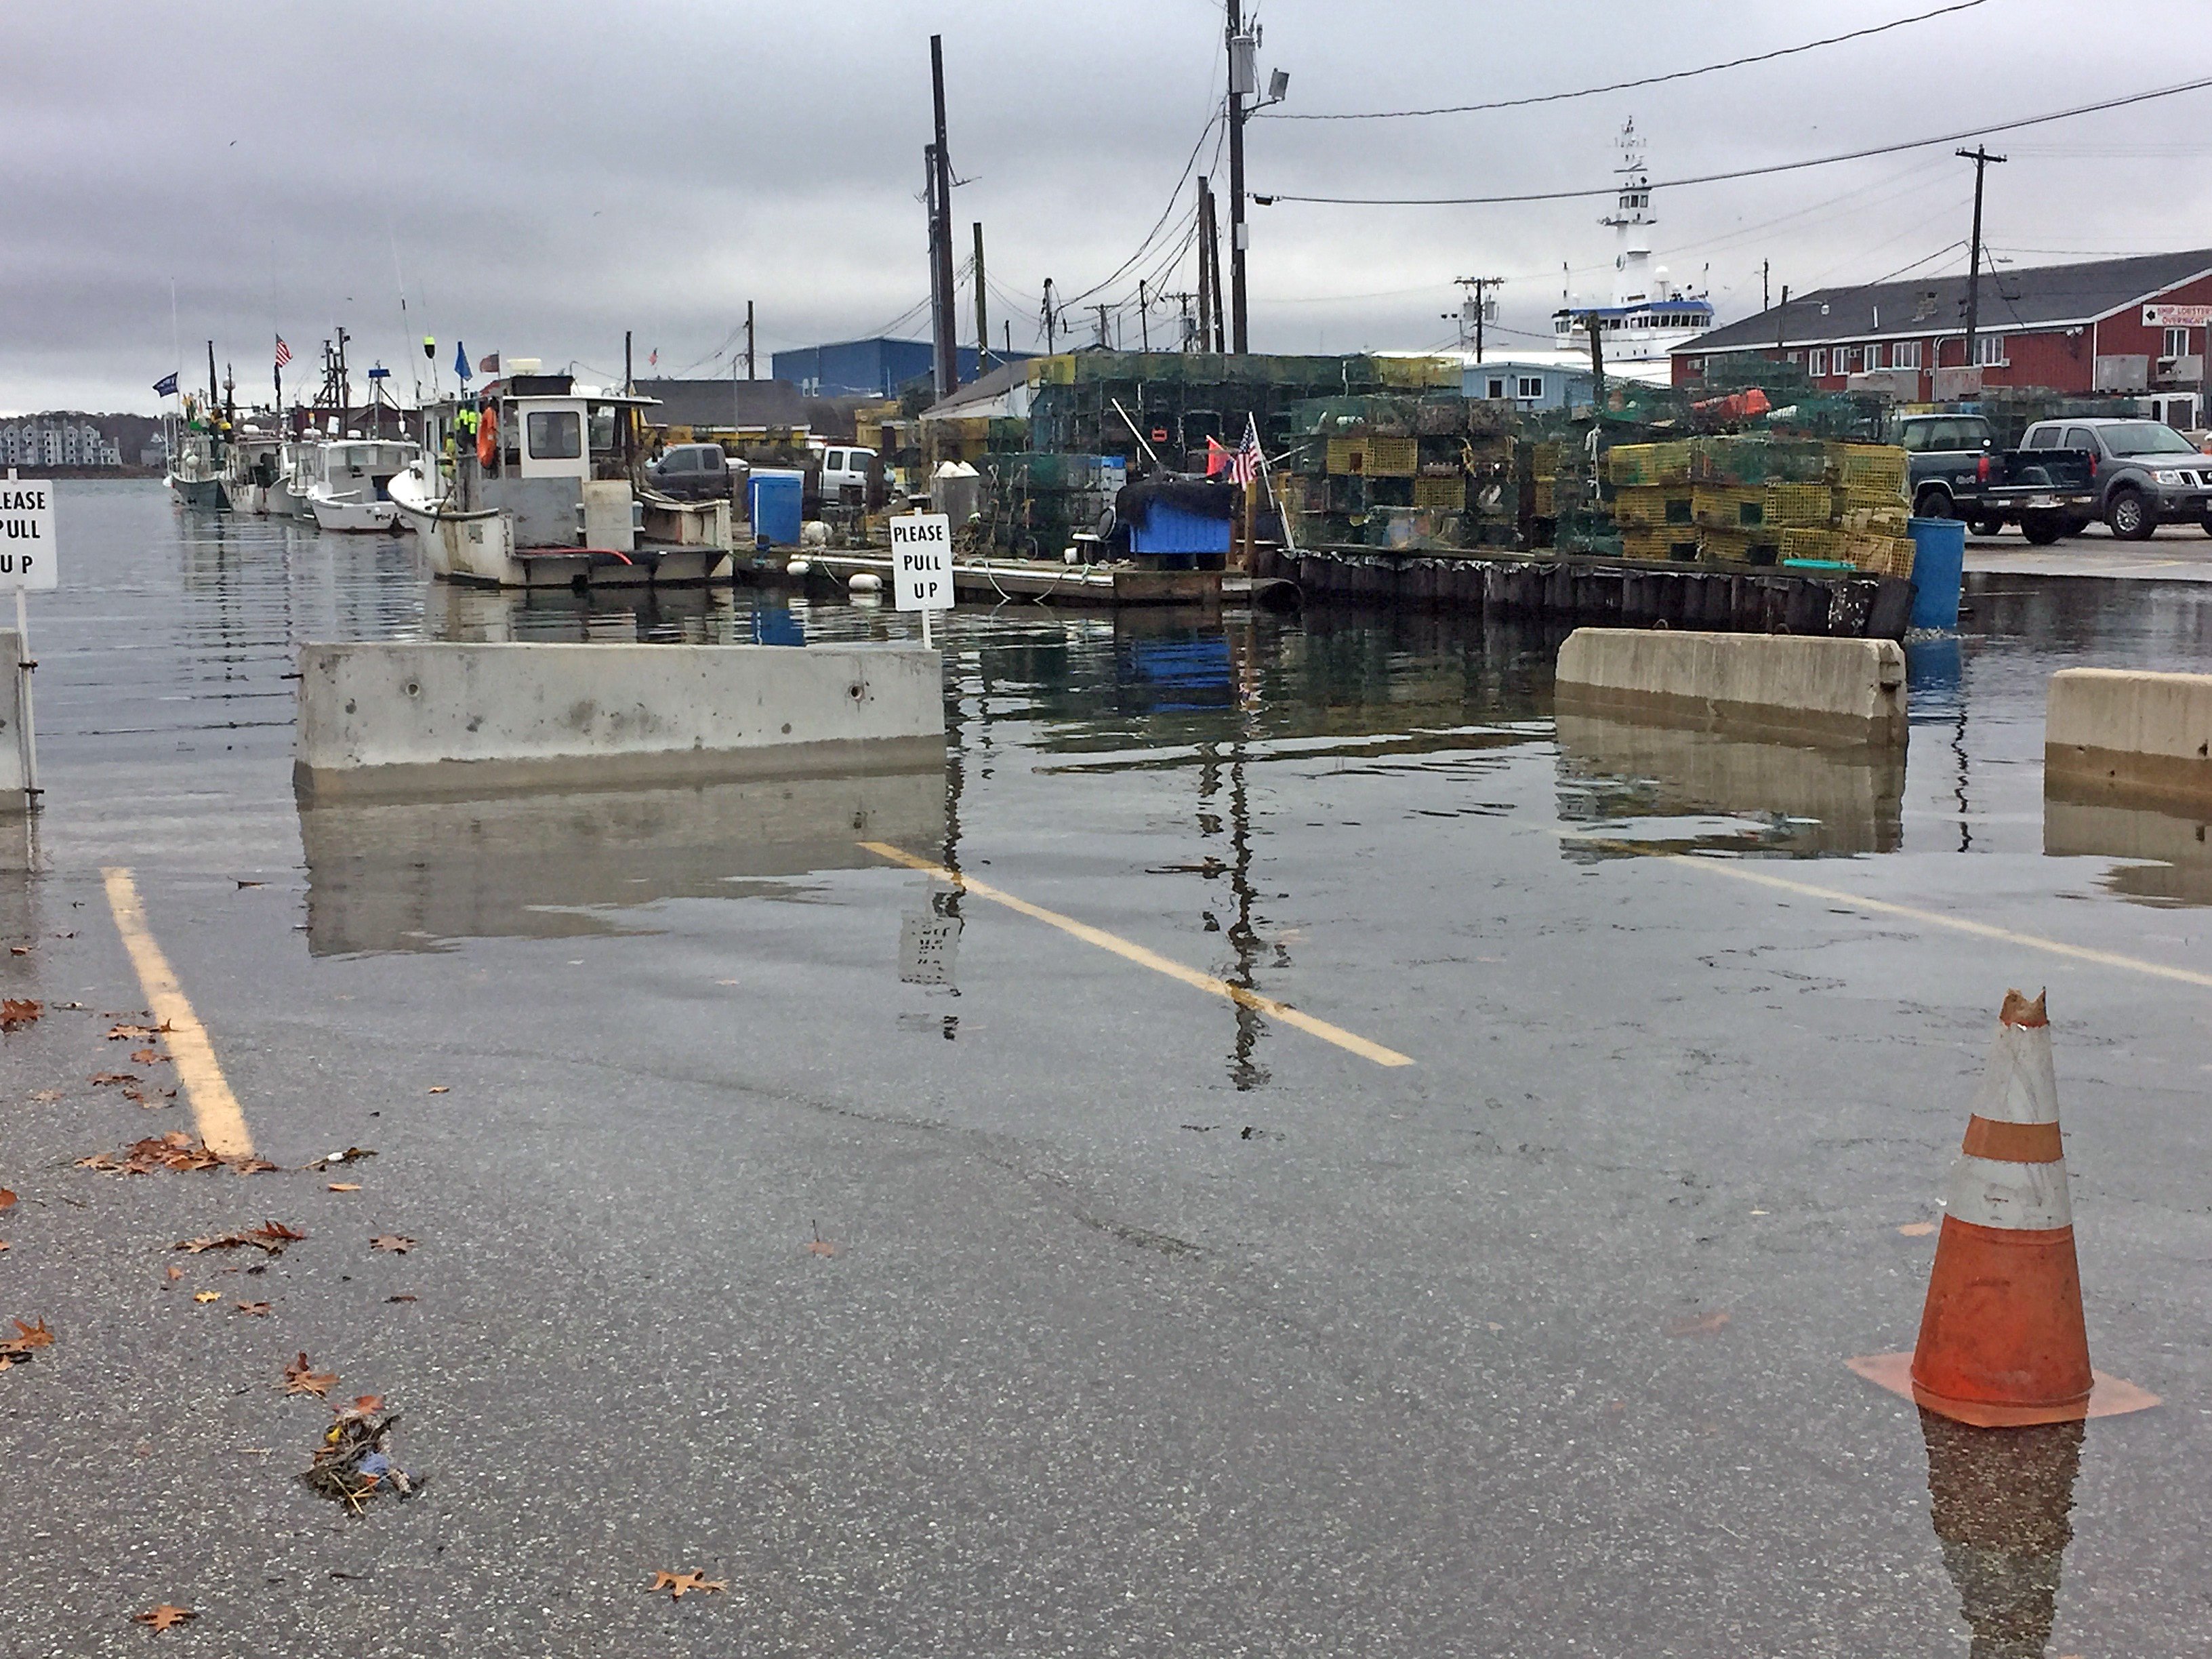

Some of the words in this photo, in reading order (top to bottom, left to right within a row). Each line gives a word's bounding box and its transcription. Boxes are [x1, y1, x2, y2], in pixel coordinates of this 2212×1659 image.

[0, 491, 45, 510] EASE
[894, 525, 943, 542] PLEASE
[0, 555, 33, 574] UP
[903, 555, 941, 571] PULL
[914, 582, 937, 598] UP
